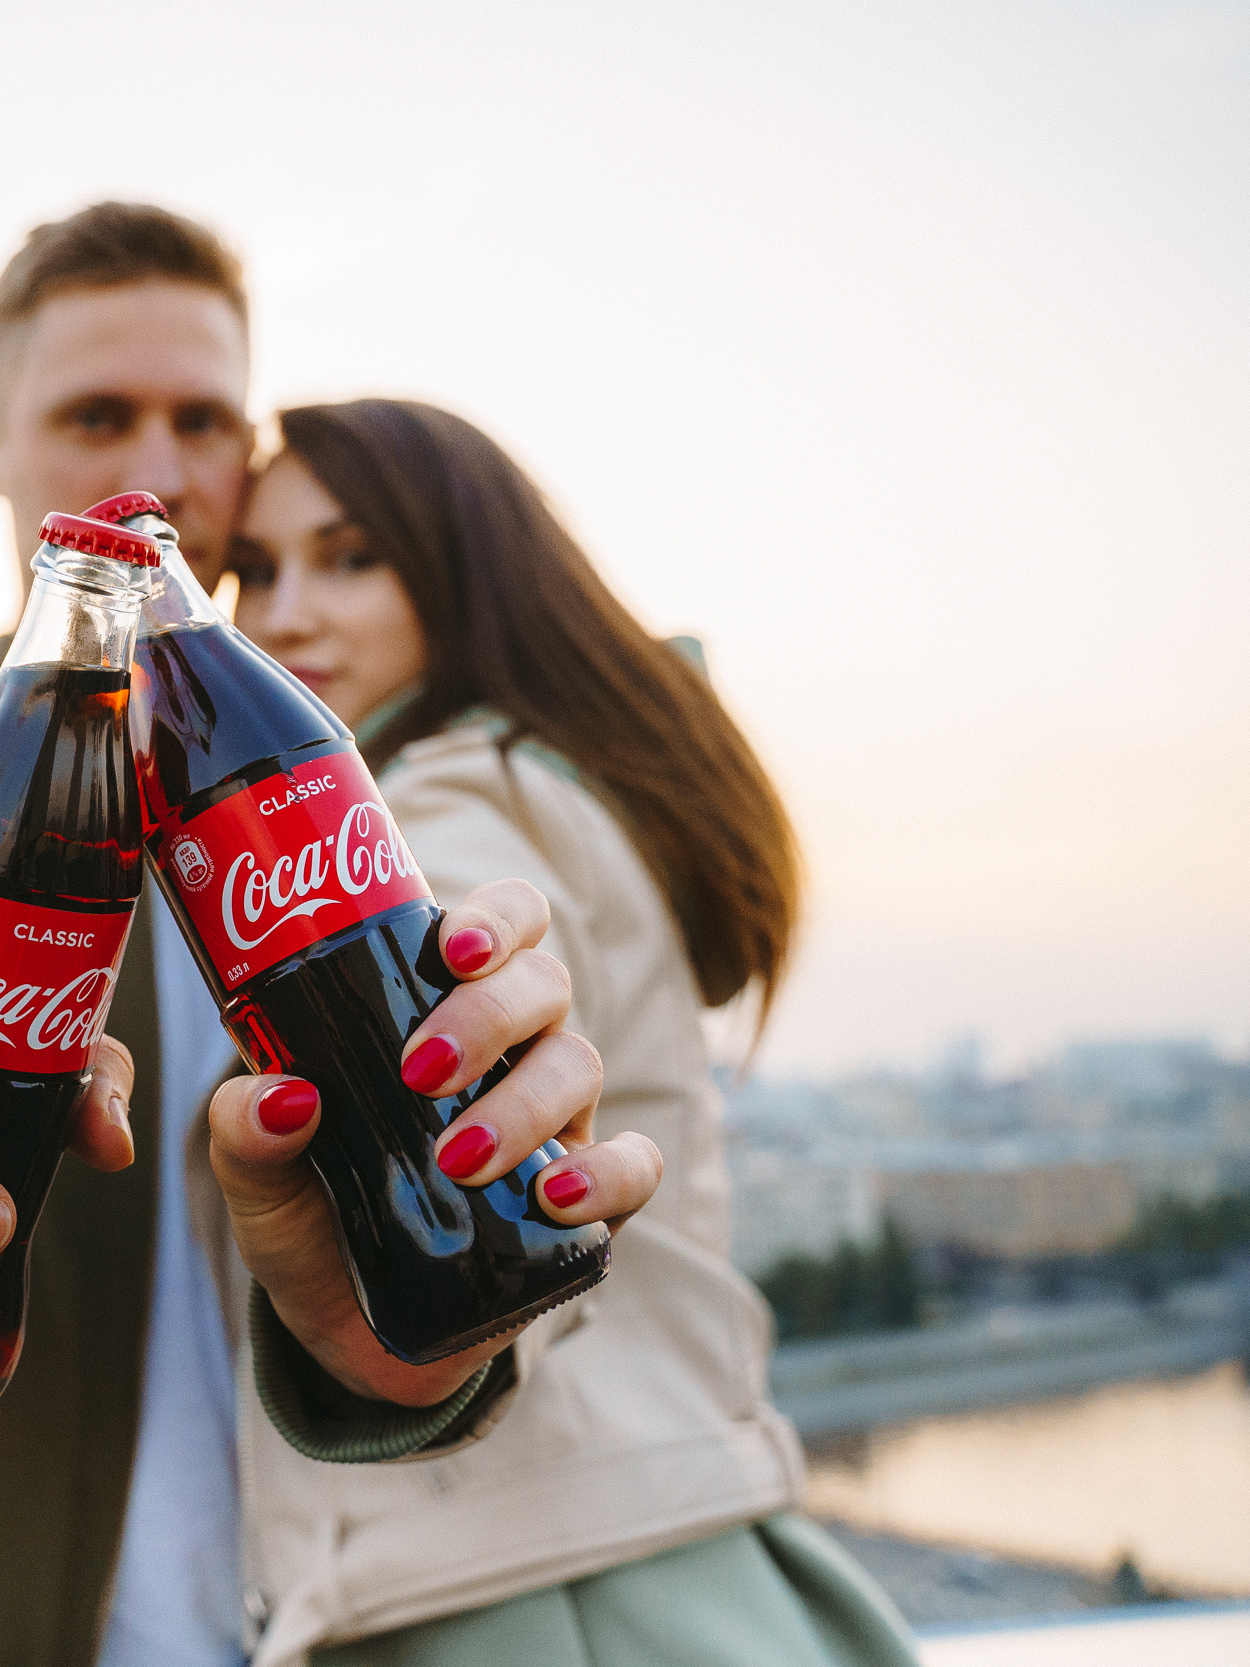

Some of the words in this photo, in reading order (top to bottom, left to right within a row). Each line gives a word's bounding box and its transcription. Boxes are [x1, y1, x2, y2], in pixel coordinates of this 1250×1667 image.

[259, 775, 337, 816] CLASSIC
[182, 851, 198, 868] 139
[13, 923, 95, 948] CLASSIC
[227, 964, 244, 982] 0,33
